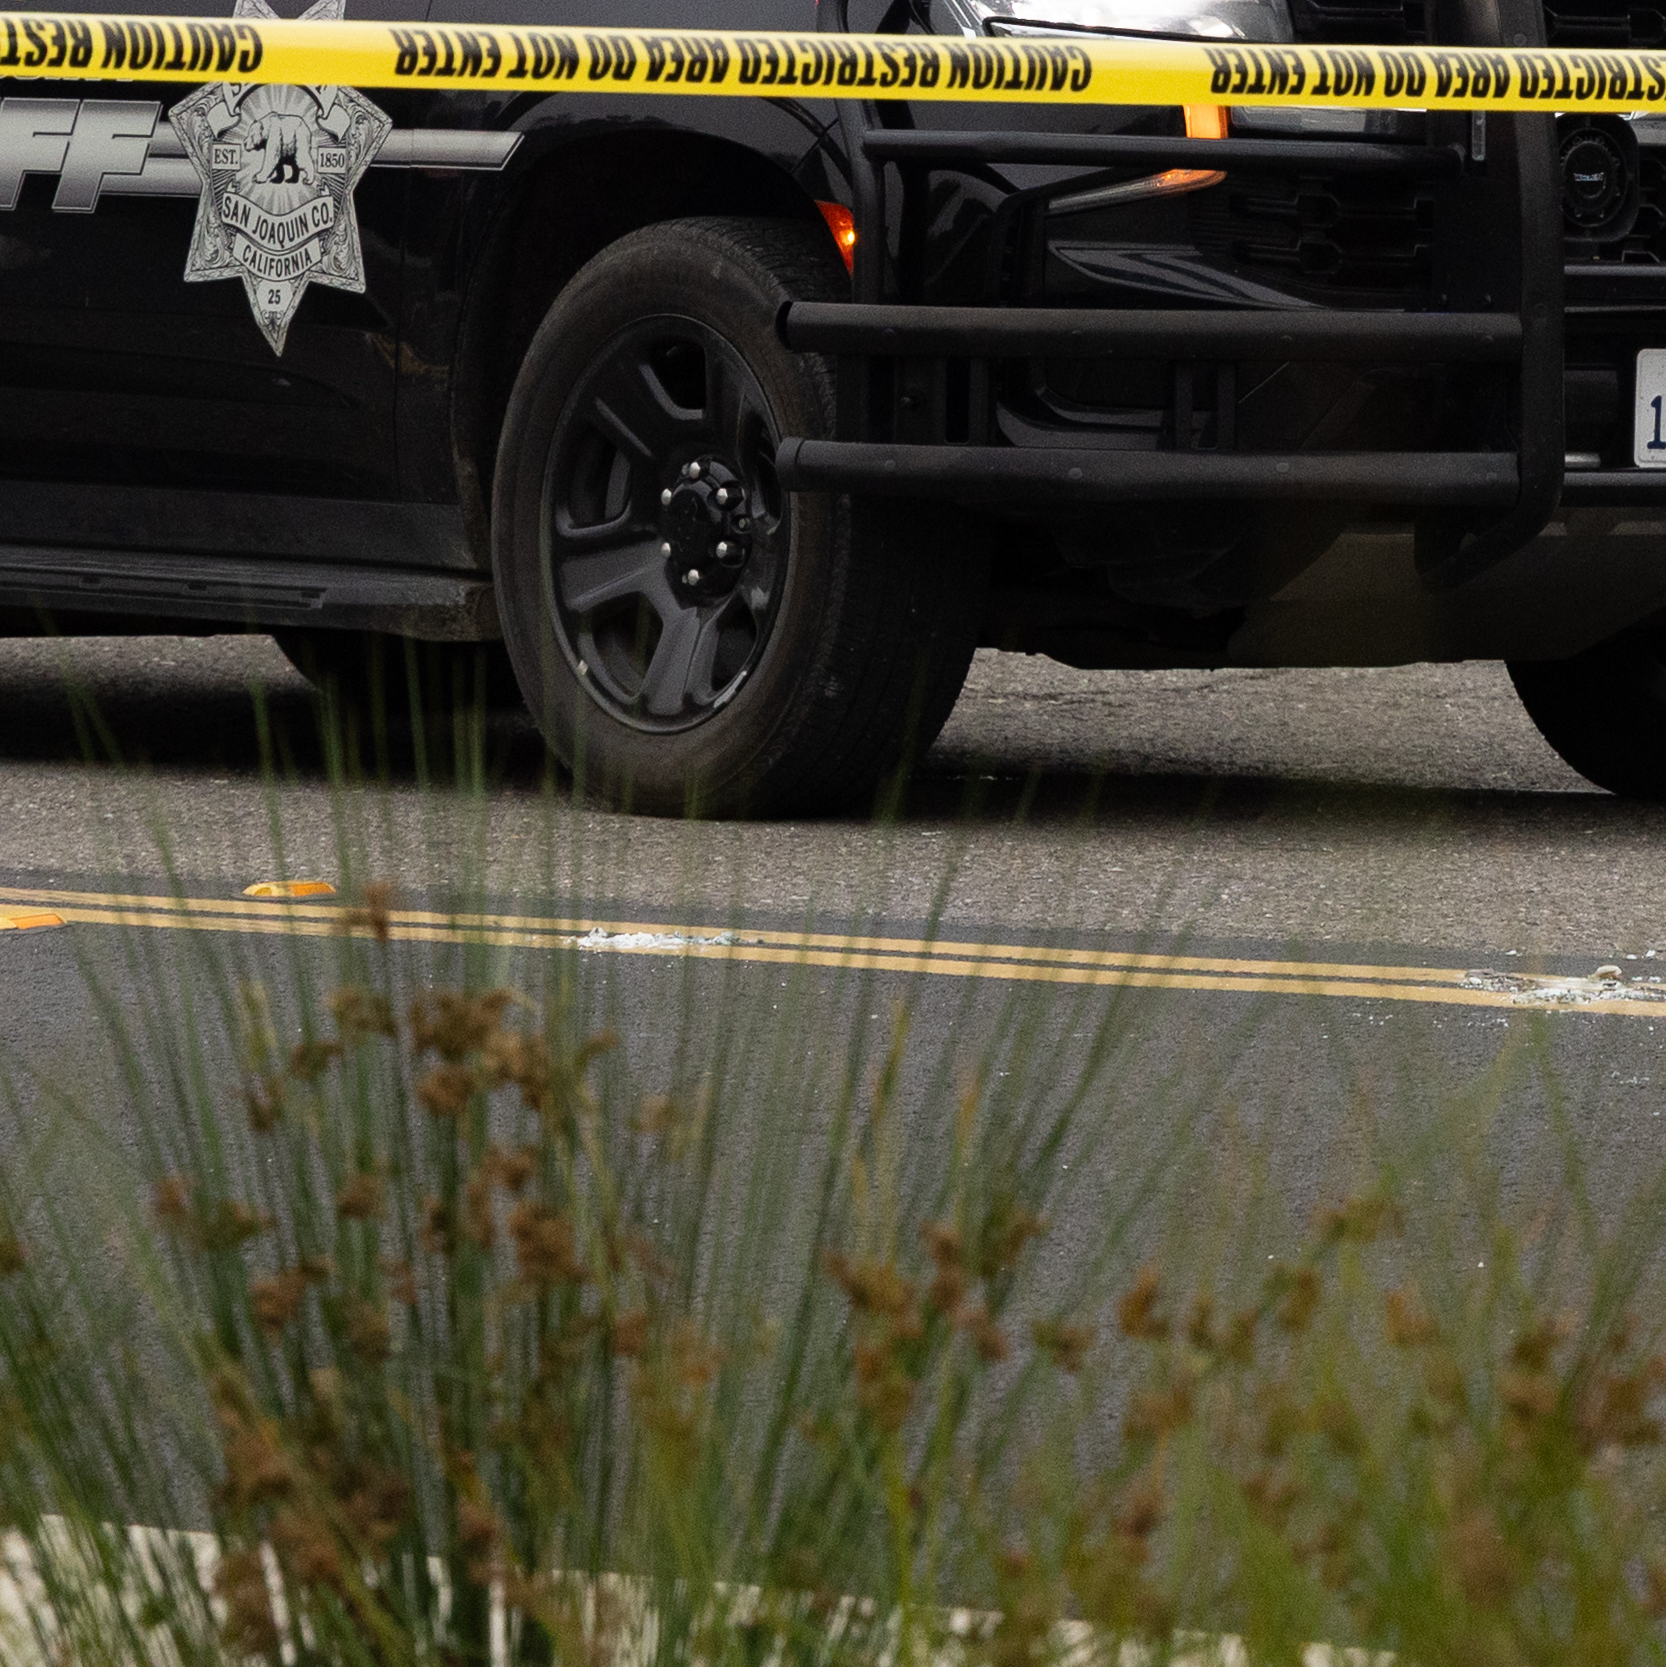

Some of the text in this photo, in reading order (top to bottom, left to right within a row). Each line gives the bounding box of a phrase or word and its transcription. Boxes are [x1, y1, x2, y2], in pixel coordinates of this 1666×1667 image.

[98, 19, 264, 74] CAUTION
[388, 26, 1093, 92] CAUTION RESTRICTED AREA DO NOT ENTER
[1202, 46, 1306, 96] ENTER
[1309, 48, 1376, 97] NOT
[1376, 50, 1427, 98] DO
[1425, 51, 1511, 99] AREA
[213, 146, 346, 169] EST. 1850
[222, 194, 334, 248] SAN JOAQUIN CO.
[241, 245, 313, 278] CALIFORNIA
[267, 288, 282, 306] 25
